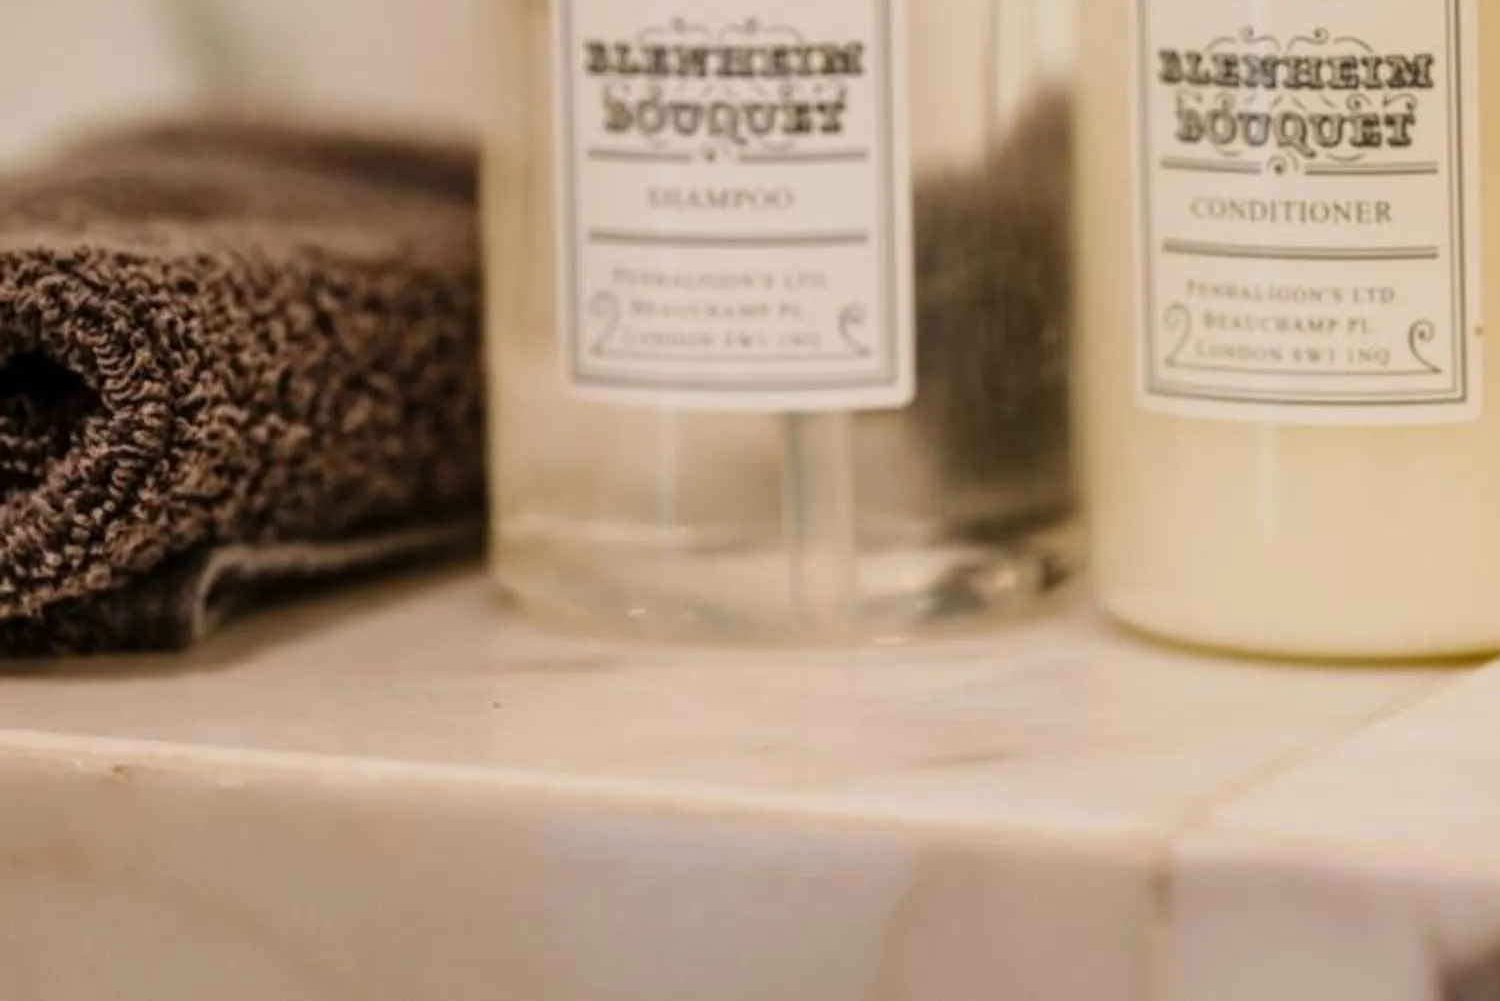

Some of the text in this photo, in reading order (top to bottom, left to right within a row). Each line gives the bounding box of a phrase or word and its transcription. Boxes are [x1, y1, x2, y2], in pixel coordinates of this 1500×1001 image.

[1159, 49, 1435, 90] BLENHEIM
[604, 99, 846, 144] BOUQUET
[1176, 111, 1417, 157] BOUQUET
[1191, 197, 1393, 225] CONDITIONER
